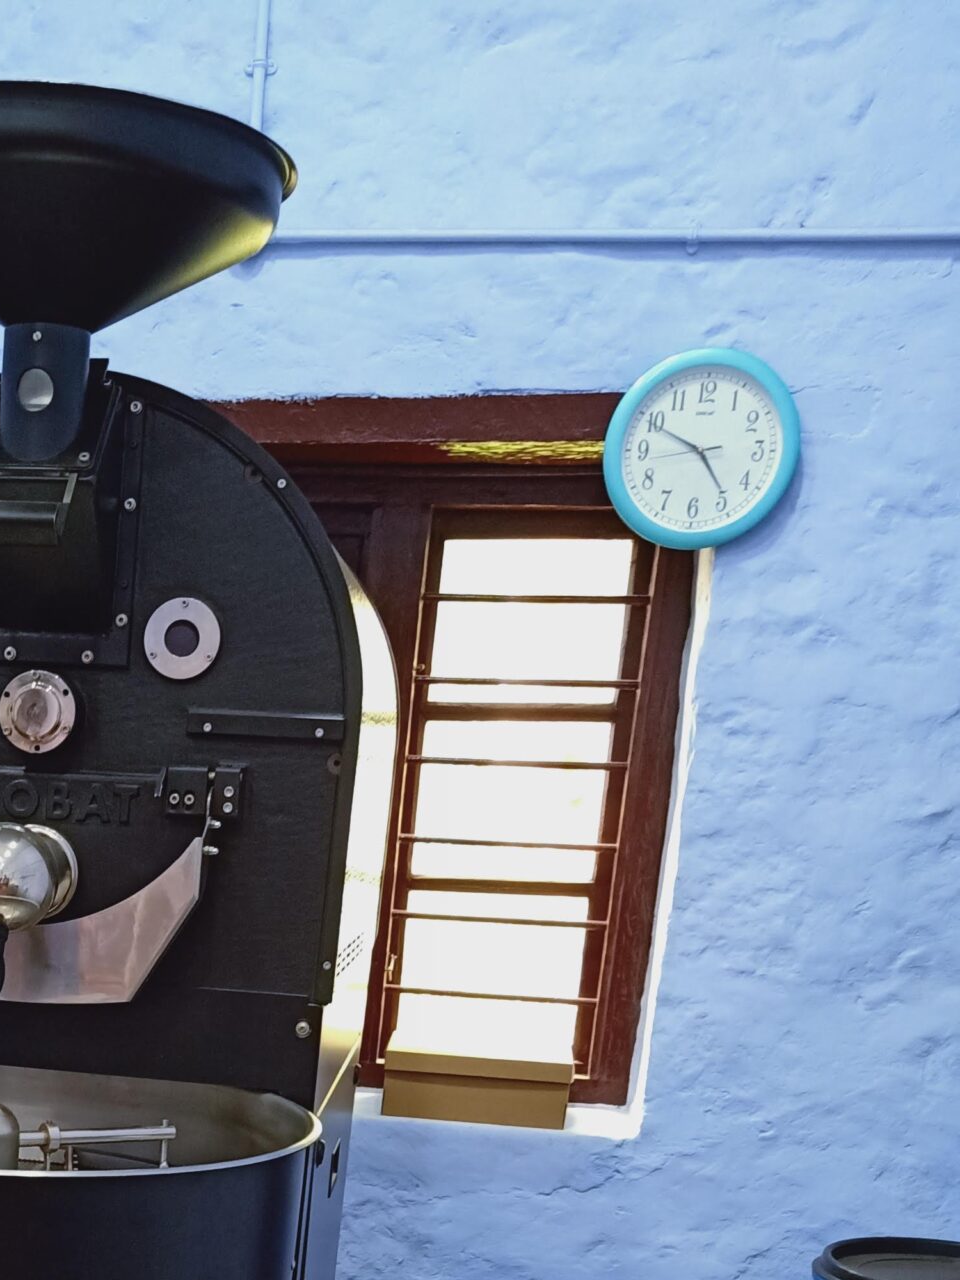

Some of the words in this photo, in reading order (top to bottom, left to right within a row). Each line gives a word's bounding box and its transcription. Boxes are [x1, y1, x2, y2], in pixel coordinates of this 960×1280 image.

[671, 389, 686, 411] 11
[697, 380, 717, 404] 12
[646, 410, 665, 433] 10
[745, 410, 759, 433] 2
[637, 439, 649, 461] 9
[751, 440, 765, 462] 3
[642, 467, 654, 490] 8
[739, 470, 751, 491] 4
[660, 489, 672, 511] 7
[687, 497, 699, 518] 6
[715, 490, 728, 512] 5
